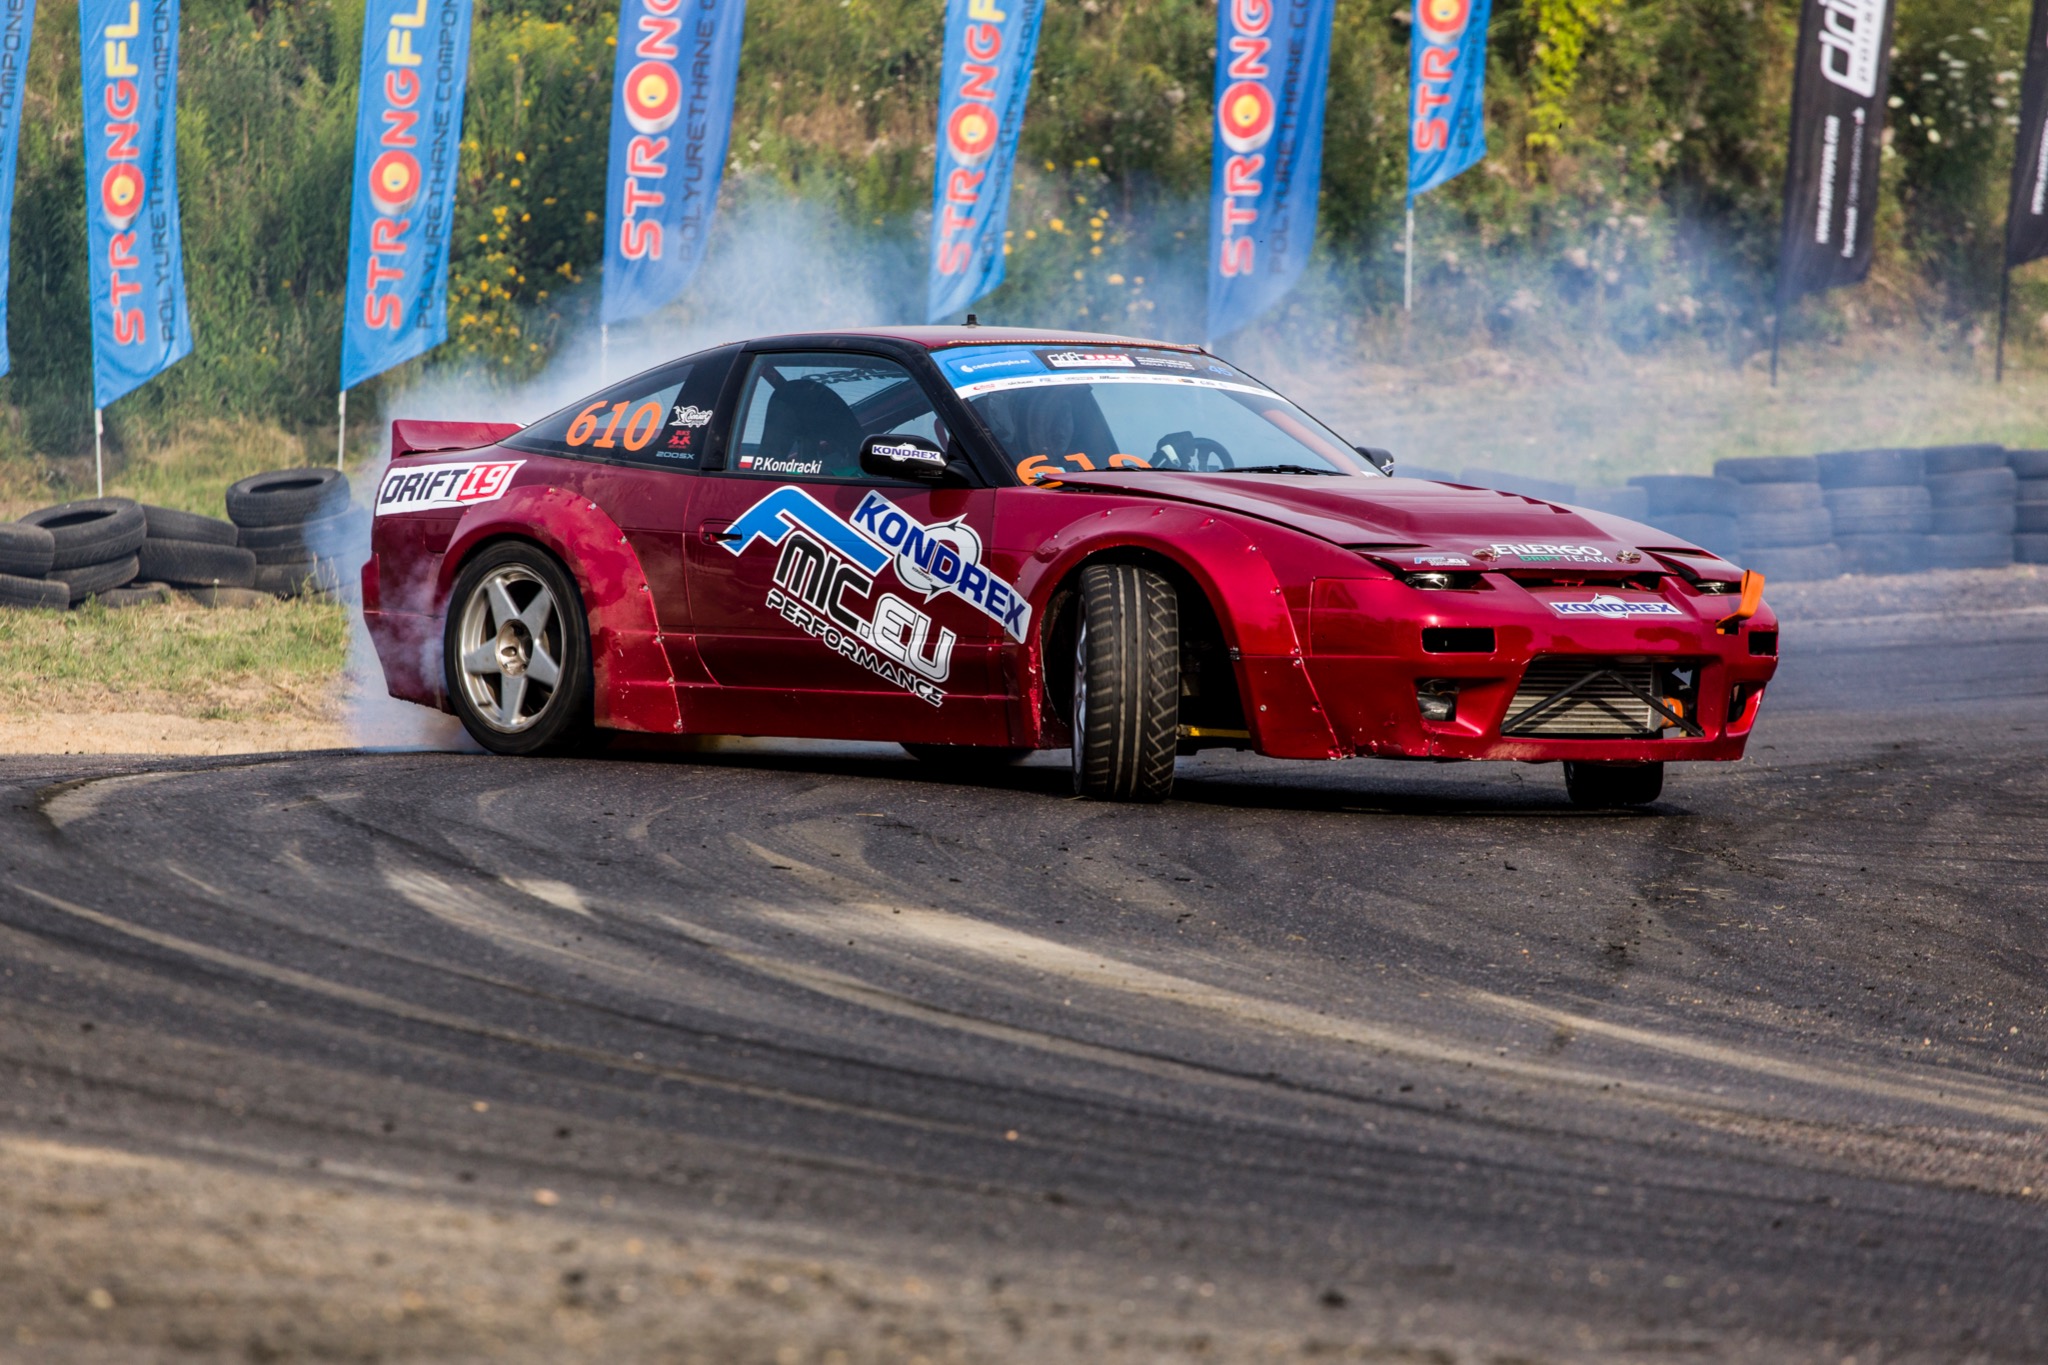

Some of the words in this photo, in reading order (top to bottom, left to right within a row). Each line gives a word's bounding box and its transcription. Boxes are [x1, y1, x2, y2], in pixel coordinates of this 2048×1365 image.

[678, 19, 715, 261] POLYURETHANE
[565, 400, 663, 451] 610
[656, 451, 695, 460] 200SX
[873, 446, 938, 460] KONDREX
[753, 456, 822, 474] P.Kondracki
[1490, 544, 1603, 557] ENERGO
[1560, 555, 1614, 564] TEAM
[854, 494, 1027, 636] KONDREX
[773, 530, 957, 682] MIC.EU
[1553, 603, 1678, 613] KONDREX
[765, 587, 948, 708] PERFORMANCE
